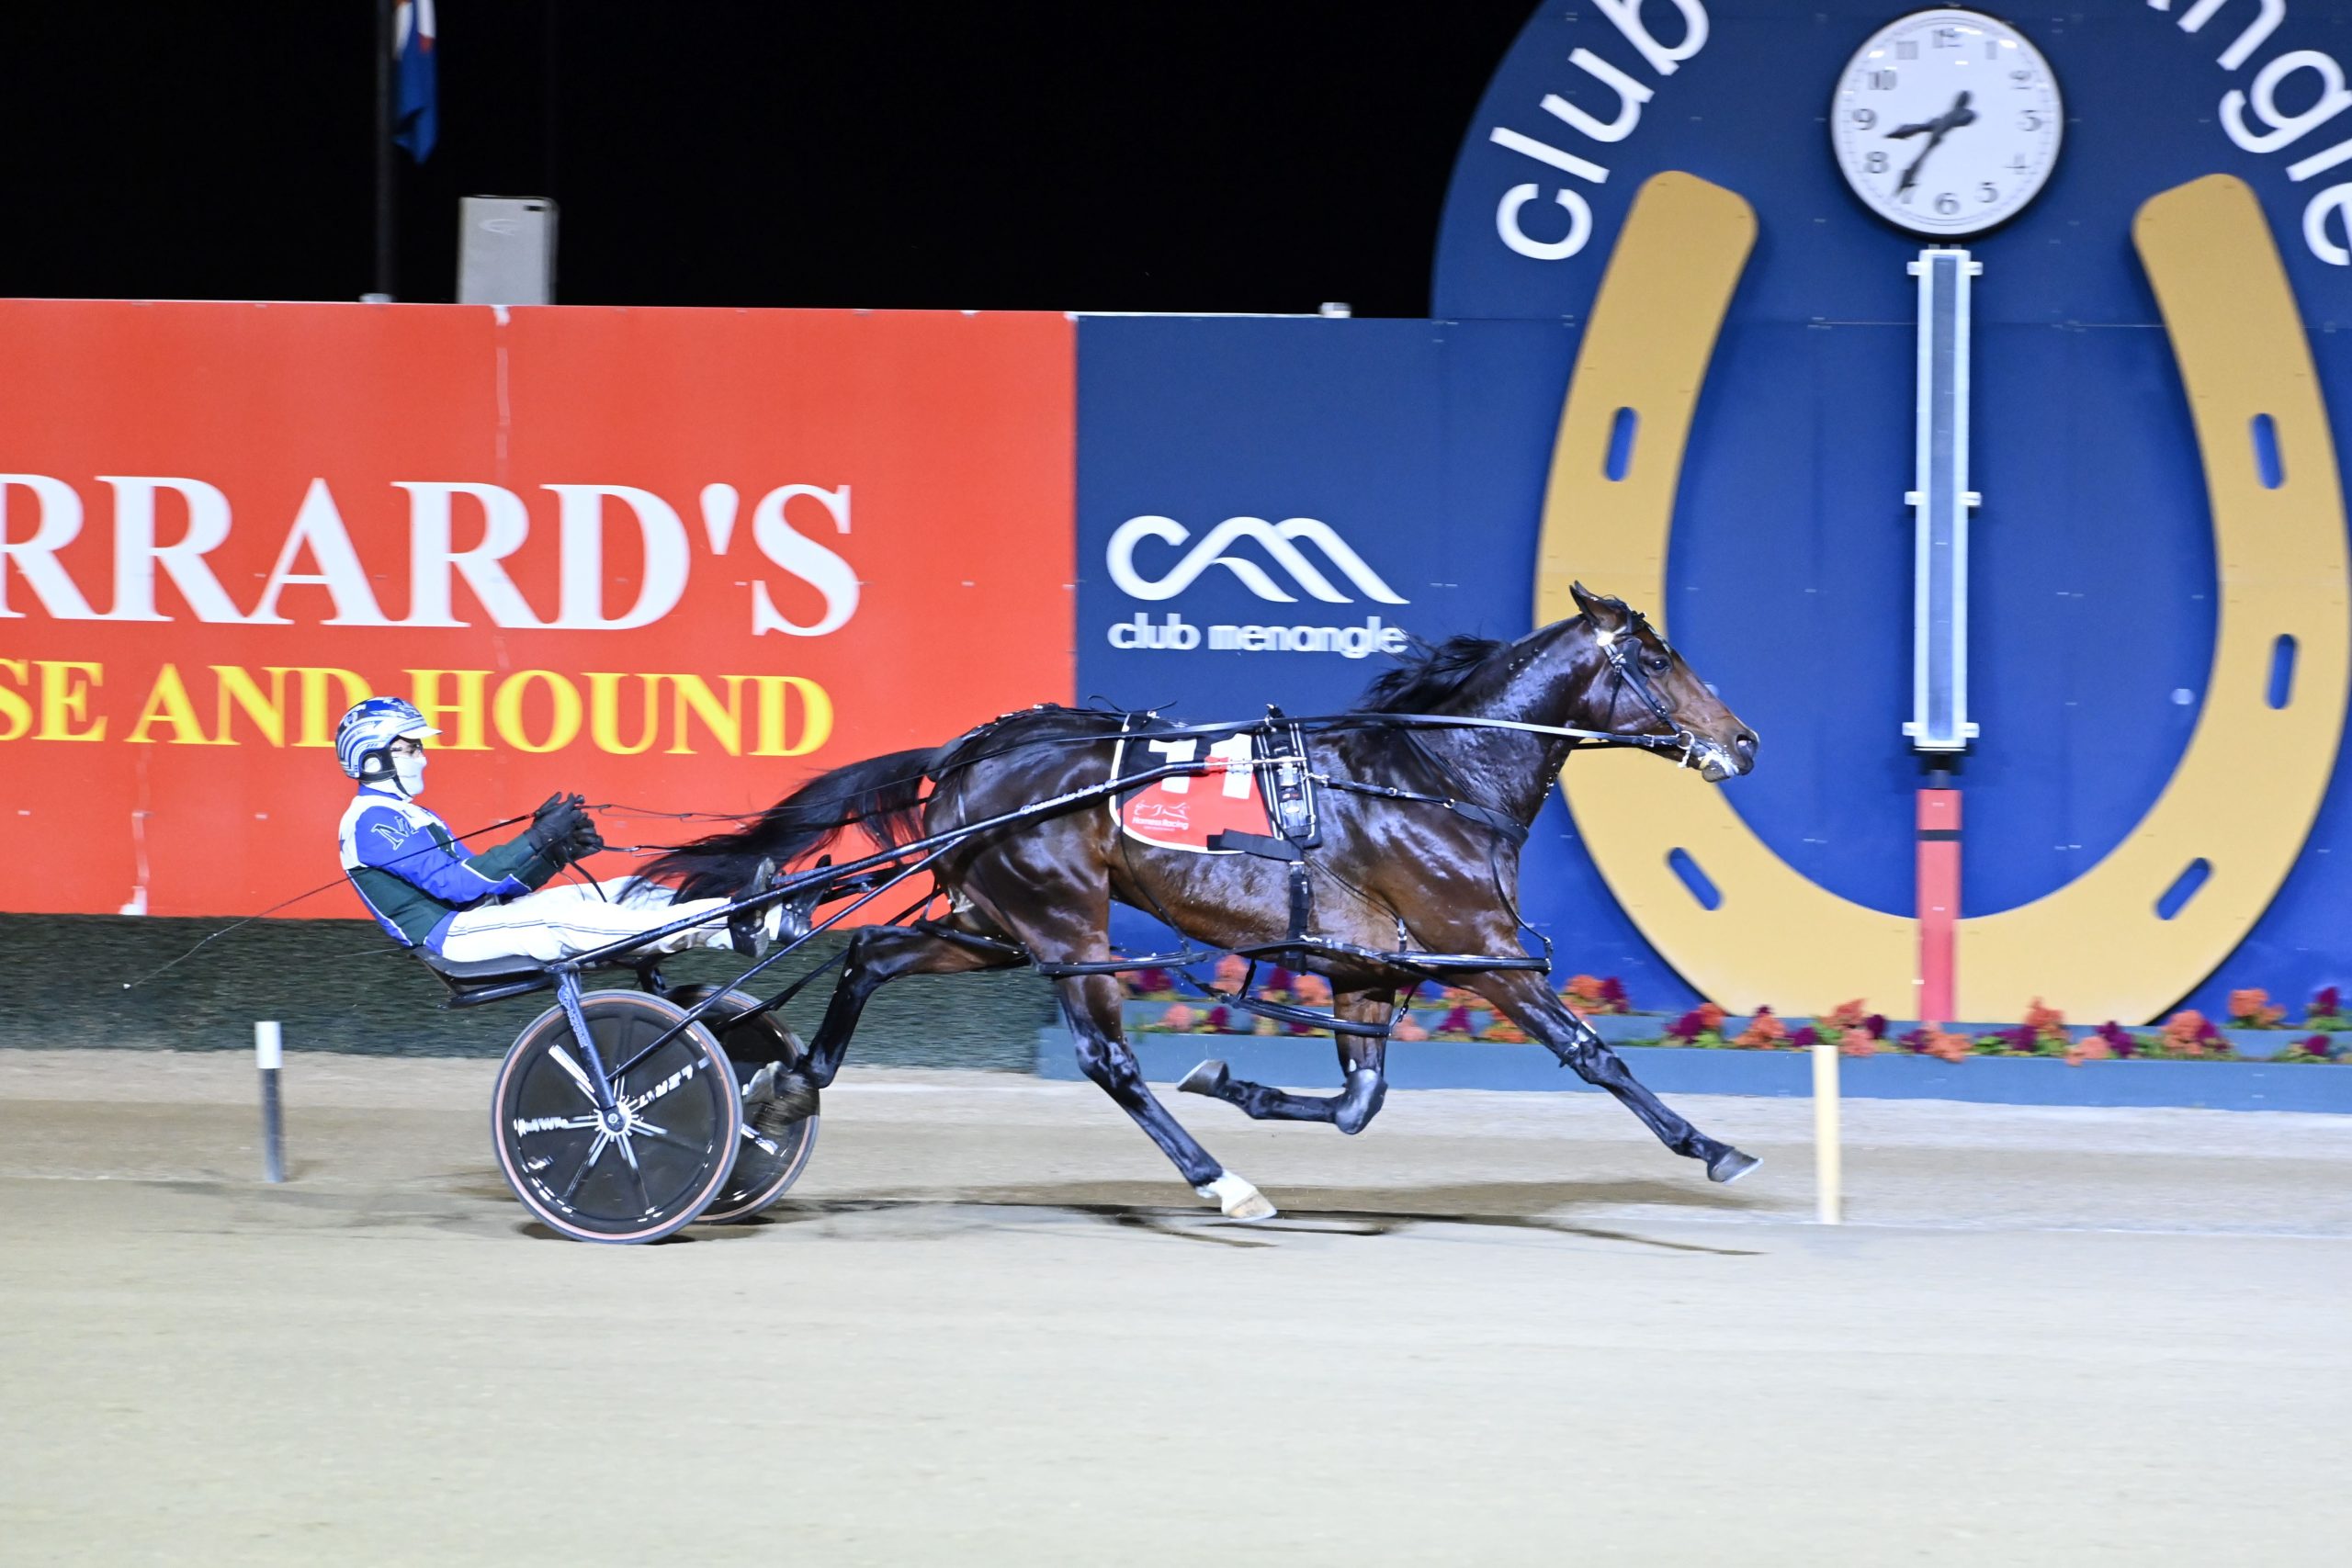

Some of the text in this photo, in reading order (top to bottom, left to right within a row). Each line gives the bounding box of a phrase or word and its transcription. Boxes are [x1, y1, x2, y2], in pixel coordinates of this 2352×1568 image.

[1489, 0, 1710, 261] club
[1851, 108, 1878, 130] 9
[1863, 151, 1891, 175] 8
[1934, 192, 1961, 216] 6
[0, 473, 861, 637] RRARD'S
[1107, 612, 1410, 660] club menangle
[123, 662, 375, 749] AND
[401, 669, 834, 757] HOUND
[1148, 732, 1254, 799] 11
